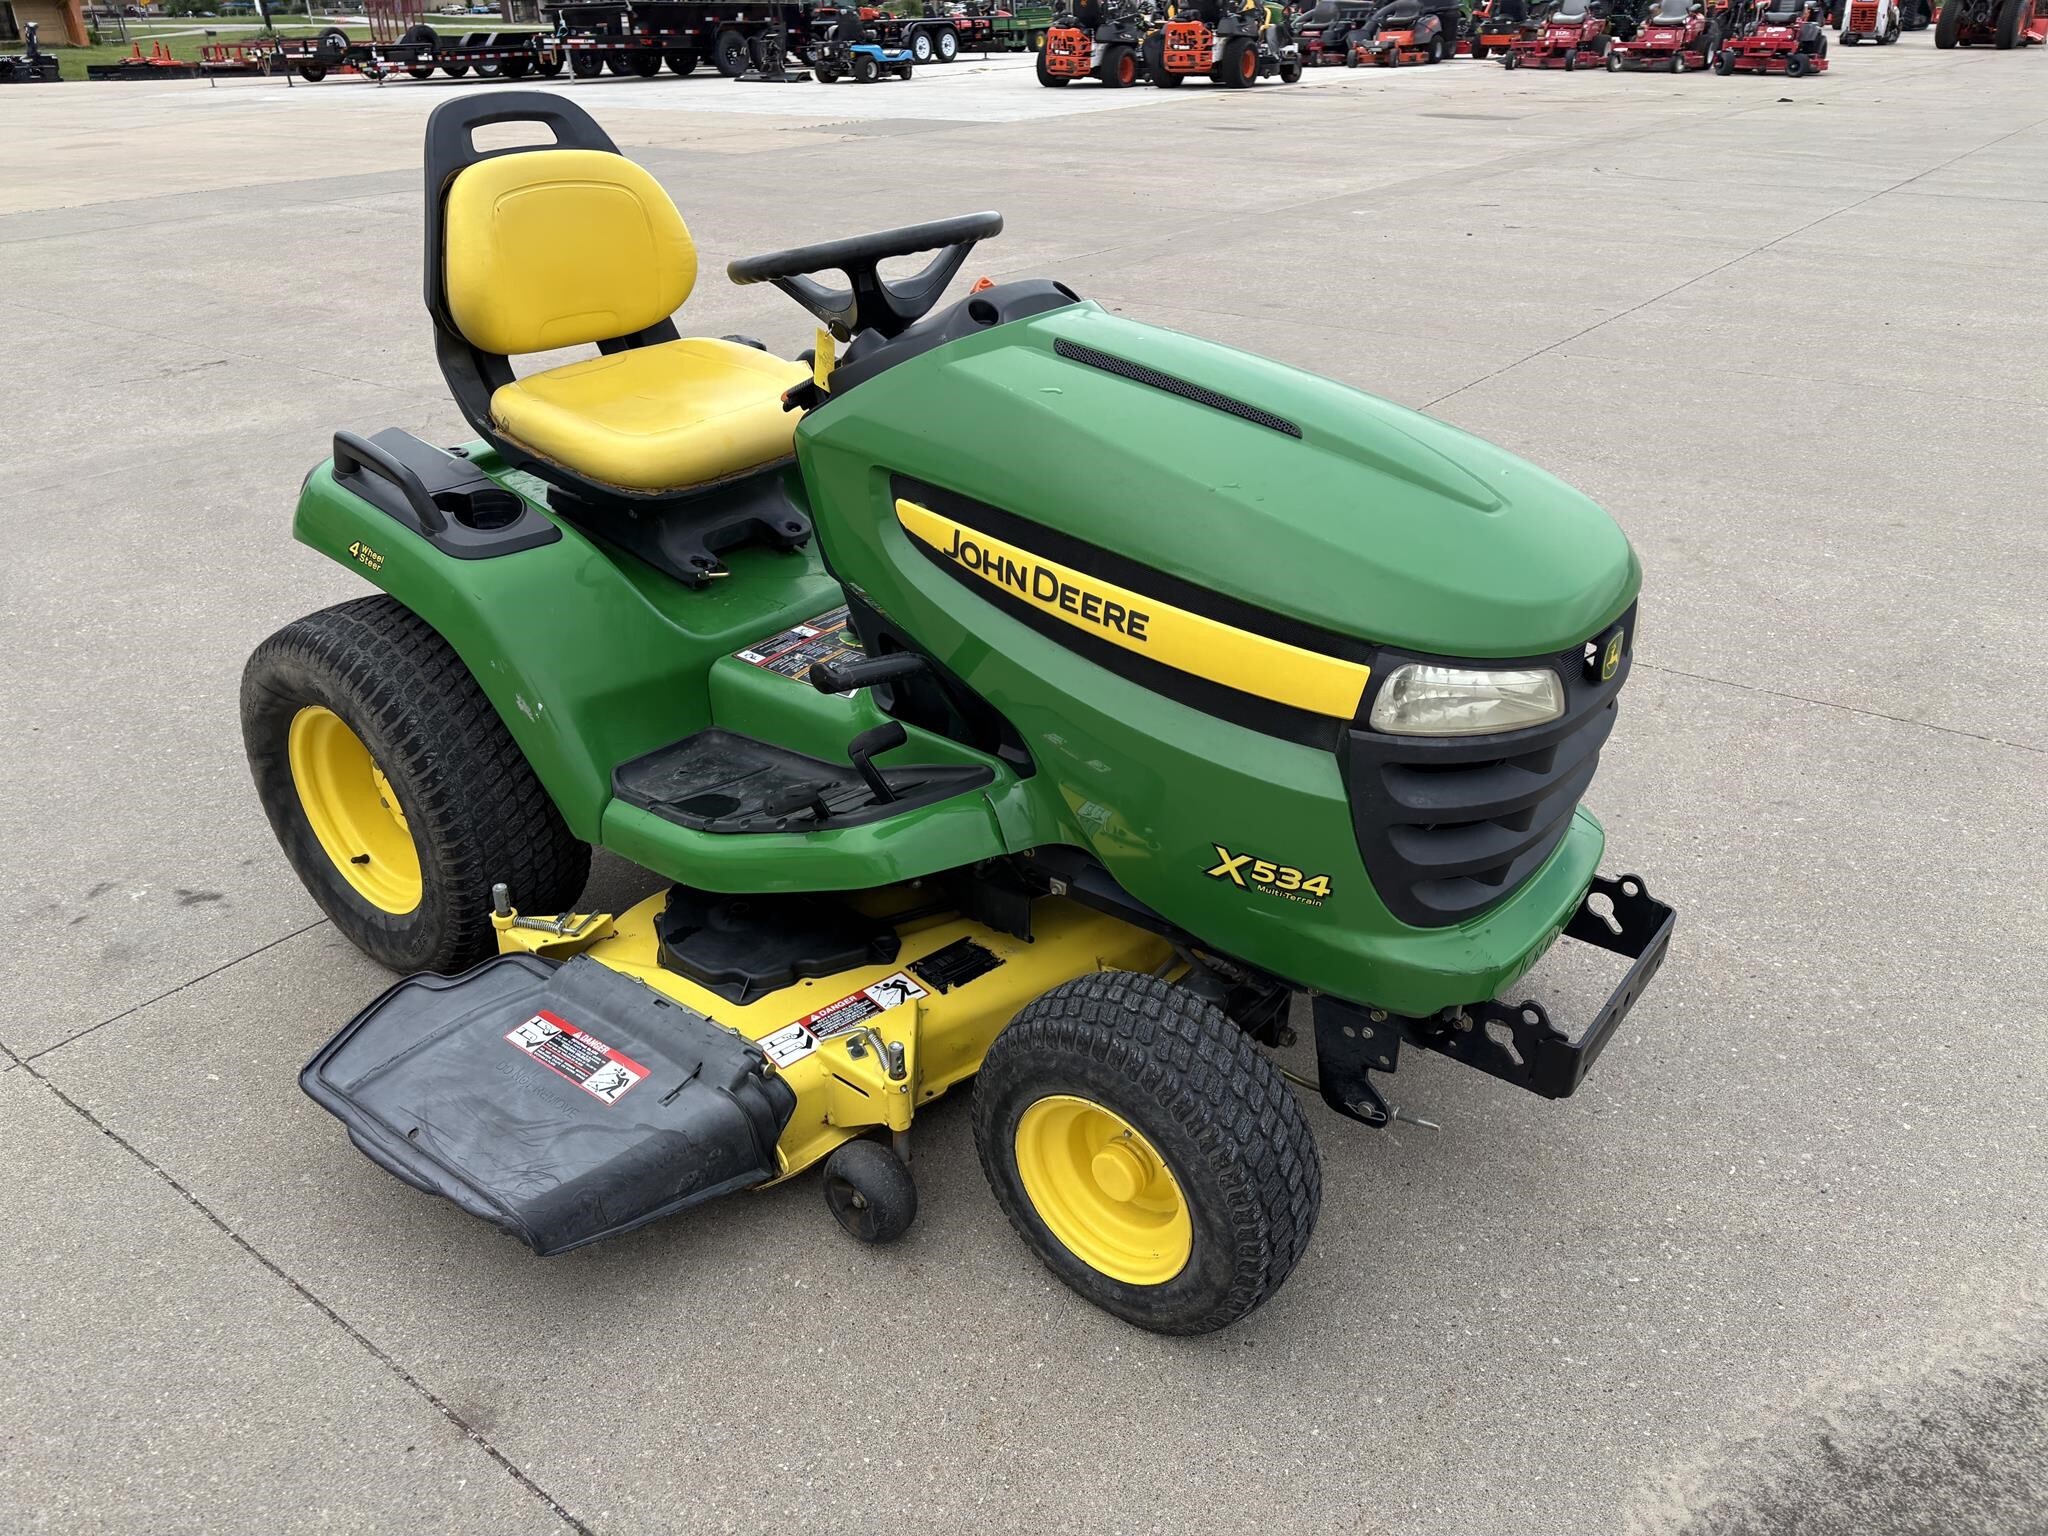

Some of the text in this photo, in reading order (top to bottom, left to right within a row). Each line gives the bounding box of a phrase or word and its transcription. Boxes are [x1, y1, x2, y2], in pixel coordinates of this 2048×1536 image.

[348, 541, 385, 564] 4 Wheel
[358, 552, 382, 572] Steer
[943, 528, 1150, 642] JOHN DEERE
[1204, 844, 1332, 898] X534
[1257, 884, 1322, 908] Multi-Terrain
[818, 994, 858, 1018] DANGER
[581, 1034, 611, 1055] DANGER
